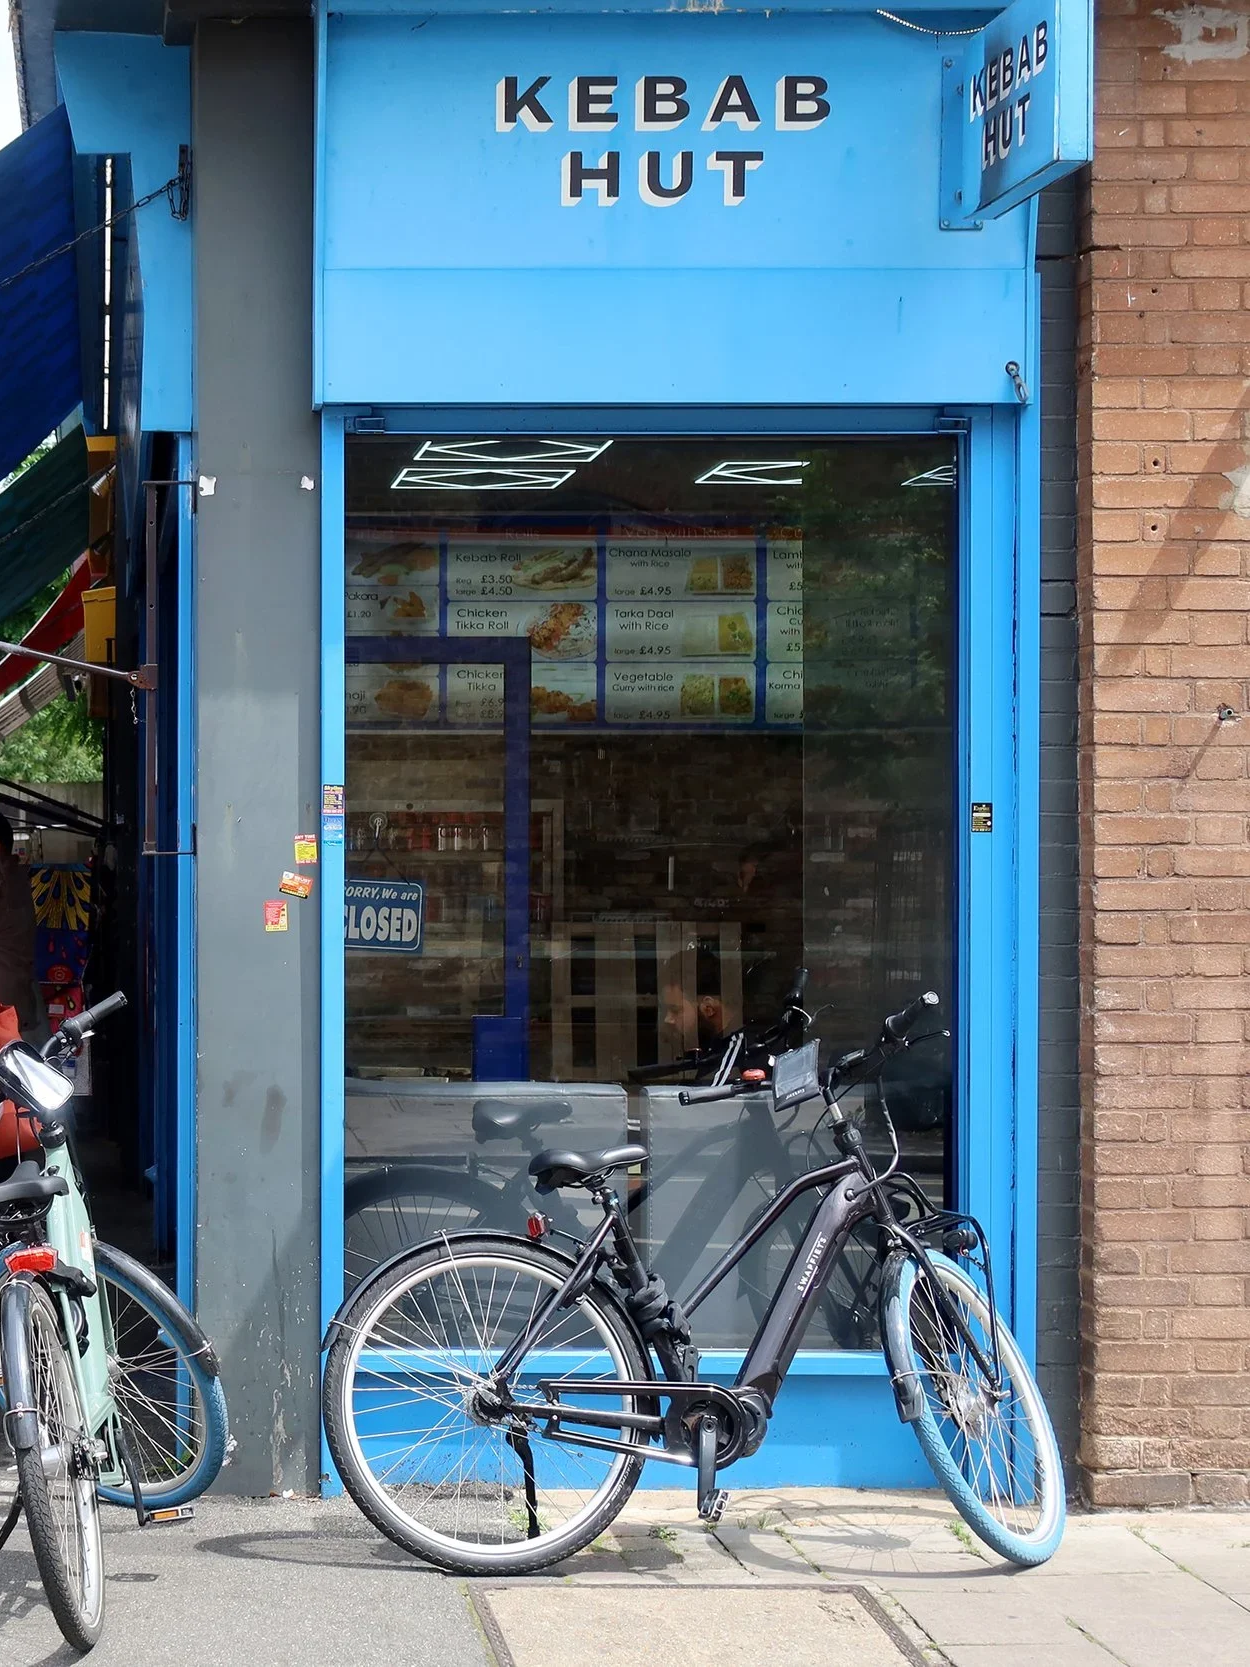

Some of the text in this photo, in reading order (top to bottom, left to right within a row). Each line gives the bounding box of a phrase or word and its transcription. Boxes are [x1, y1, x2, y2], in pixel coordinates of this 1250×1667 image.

[970, 20, 1048, 123] KEBAB
[496, 75, 831, 132] KEBAB
[982, 93, 1030, 172] HUT
[561, 151, 764, 207] HUT
[454, 553, 521, 562] Kebab Roll
[608, 548, 647, 558] Chana
[480, 575, 512, 585] £3.50
[480, 586, 512, 596] £4.50
[638, 586, 672, 597] £4.95
[456, 608, 507, 618] Chicken
[614, 608, 674, 619] Tarka Daal
[454, 620, 509, 630] Tikka Roll
[618, 620, 669, 631] with Rice
[638, 645, 671, 656] £4.95
[612, 671, 673, 683] Vegetable
[467, 682, 496, 691] Tikka
[611, 683, 634, 693] Curry
[636, 683, 656, 692] with
[344, 885, 380, 900] ORRY,
[400, 891, 419, 901] are
[797, 1236, 828, 1292] SWAPFIETS
